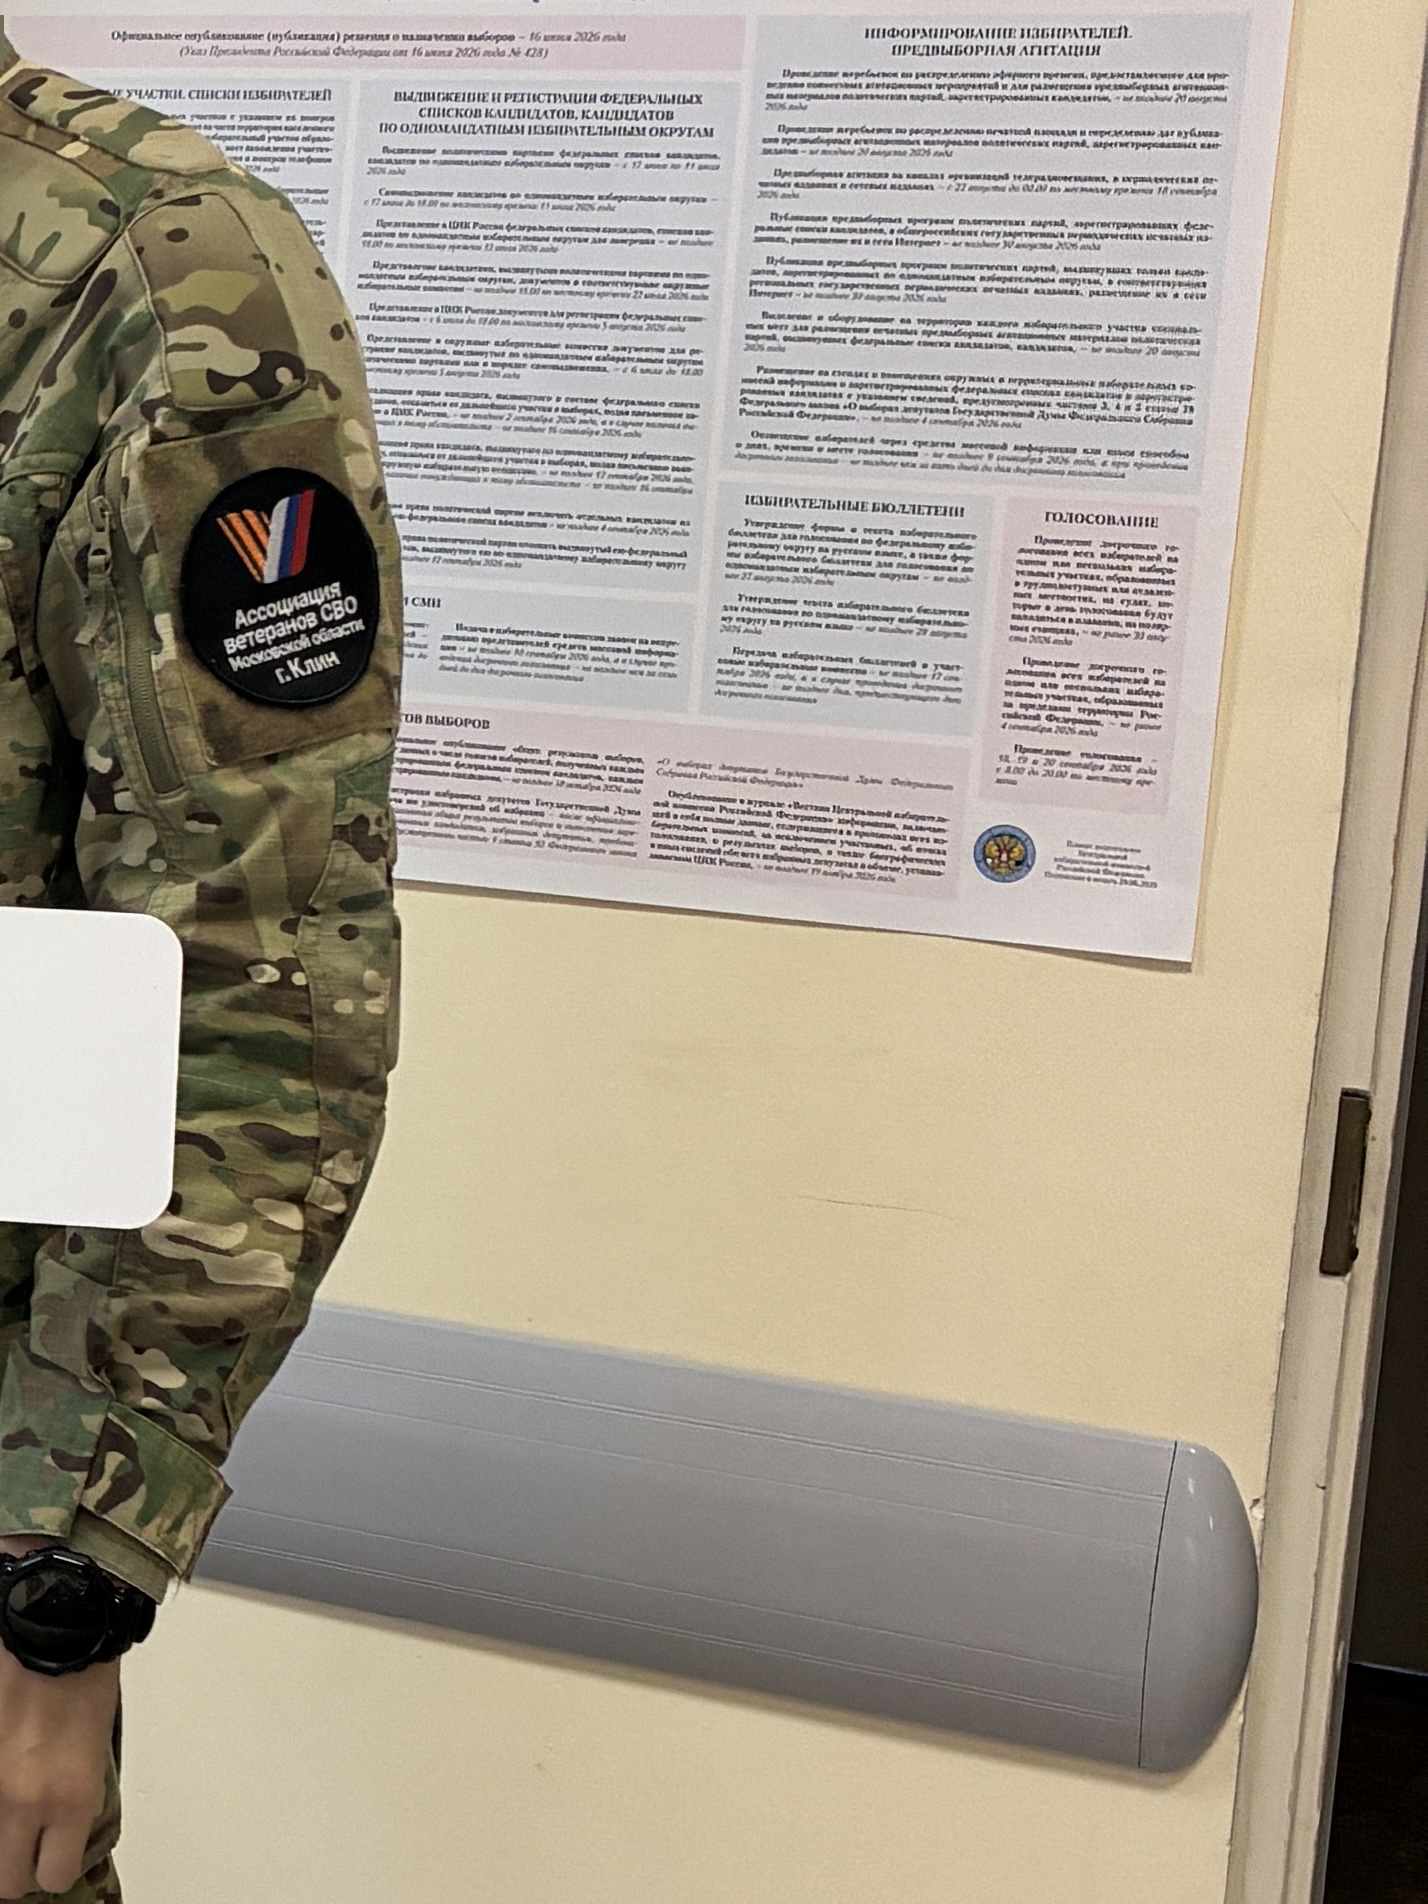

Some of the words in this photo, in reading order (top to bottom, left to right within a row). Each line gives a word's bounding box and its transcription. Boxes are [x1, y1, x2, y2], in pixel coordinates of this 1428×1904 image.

[865, 27, 1017, 39] ИНФОРМИРОВАНИЕ
[1020, 25, 1132, 39] ИЗБИРАТЕЛЕЙ.
[892, 44, 1016, 57] ПРЕДВЫБОРНАЯ
[1020, 44, 1101, 57] АГИТАЦИЯ
[124, 89, 184, 100] УЧАСТКИ.
[188, 89, 241, 100] СПИСКИ
[243, 88, 332, 101] ИЗБИРАТЕЛЕЙ
[394, 91, 489, 103] ВЫДВИЖЕНИЕ
[491, 92, 501, 103] И
[600, 93, 703, 105] ФЕДЕРАЛЬНЫХ
[418, 107, 482, 118] СПИСКОВ
[485, 108, 578, 120] КАНДИДАТОВ,
[581, 109, 674, 121] КАНДИДАТОВ
[379, 123, 398, 133] ПО
[400, 123, 525, 135] ОДНОМАНДАТНЫМ
[528, 125, 646, 136] ИЗБИРАТЕЛЬНЫМ
[649, 127, 714, 138] ОКРУГАМ
[745, 495, 869, 512] ИЗБИРАТЕЛЬНЫЕ
[871, 502, 964, 517] БЮЛЛЕТЕНИ
[1045, 512, 1158, 528] ГОЛОСОВАНИЕ
[235, 582, 341, 629] Ассоциация
[411, 597, 441, 608] СМИ
[223, 611, 318, 654] ветеранов
[320, 596, 358, 622] СВО
[228, 632, 312, 672] Московской
[313, 618, 366, 645] области
[425, 715, 490, 729] ВЫБОРОВ
